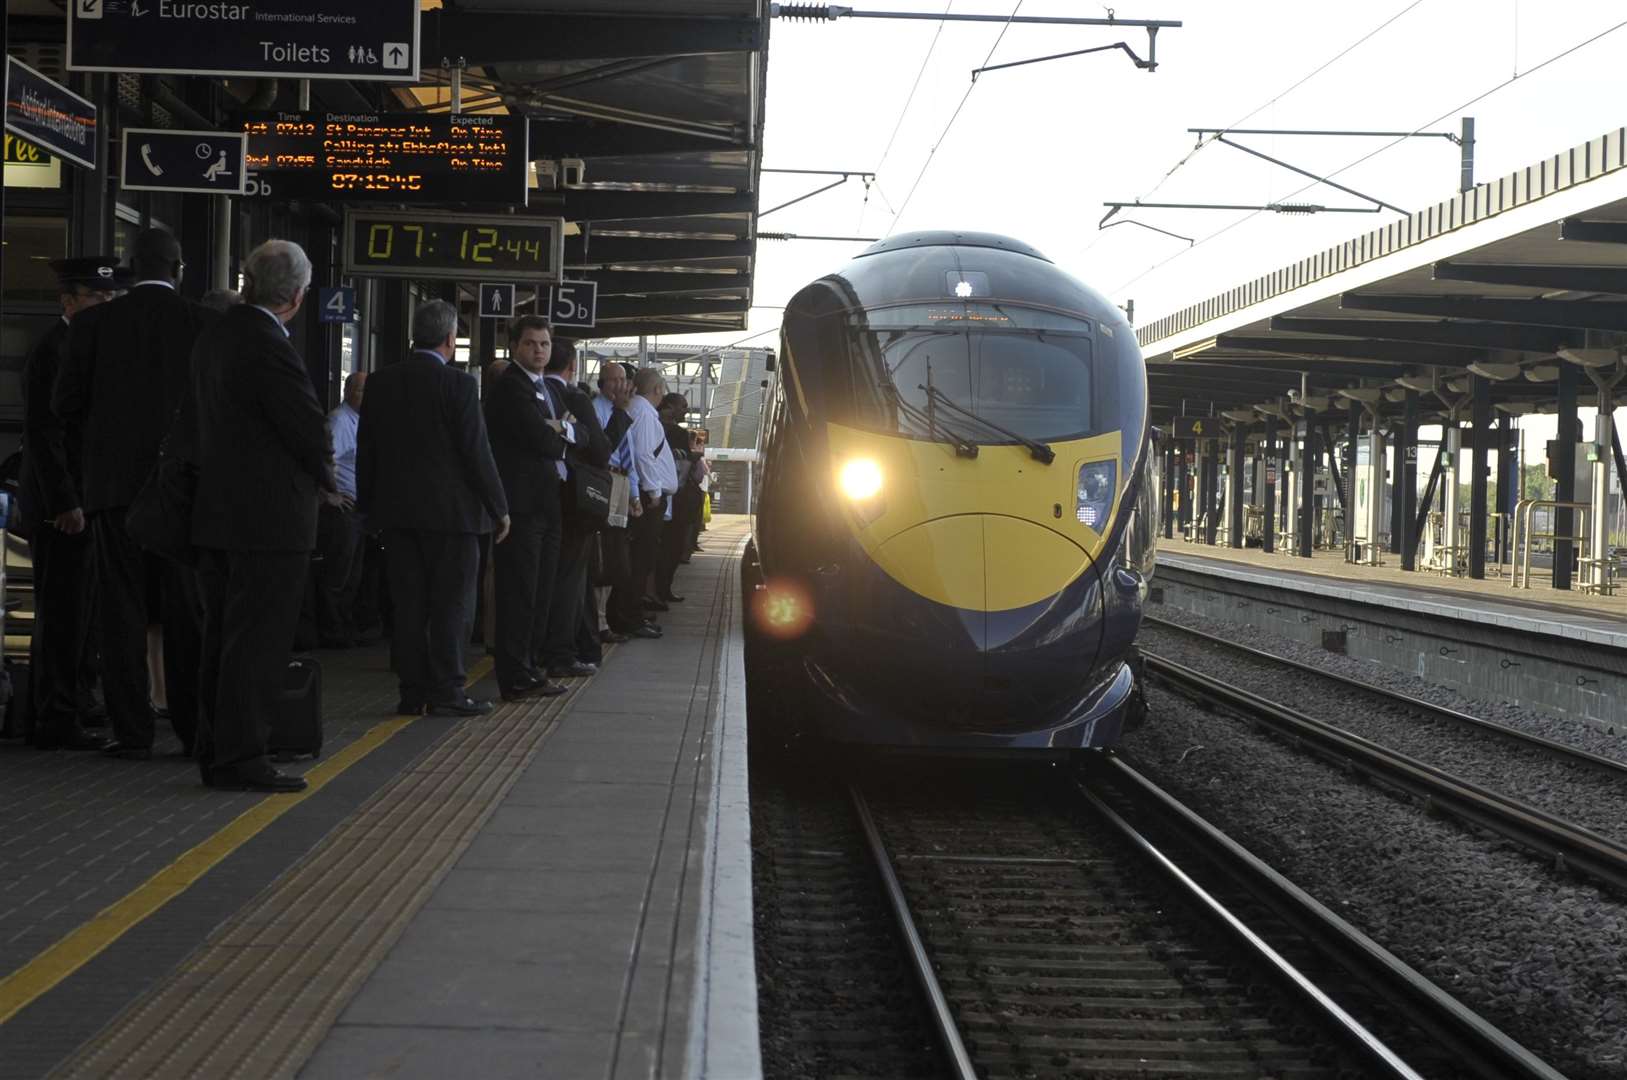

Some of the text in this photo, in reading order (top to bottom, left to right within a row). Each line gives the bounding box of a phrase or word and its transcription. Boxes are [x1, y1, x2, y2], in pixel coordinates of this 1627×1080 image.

[159, 0, 250, 20] Eurostar
[255, 12, 356, 25] International Services
[260, 42, 330, 63] Toilets
[278, 112, 494, 125] Time Destination Expected
[451, 126, 502, 139] On Time
[451, 158, 502, 171] On Time
[331, 173, 422, 190] 07:12:45
[326, 291, 347, 314] 4
[556, 288, 588, 319] 5b
[1192, 420, 1204, 435] 4
[1405, 446, 1417, 459] 13
